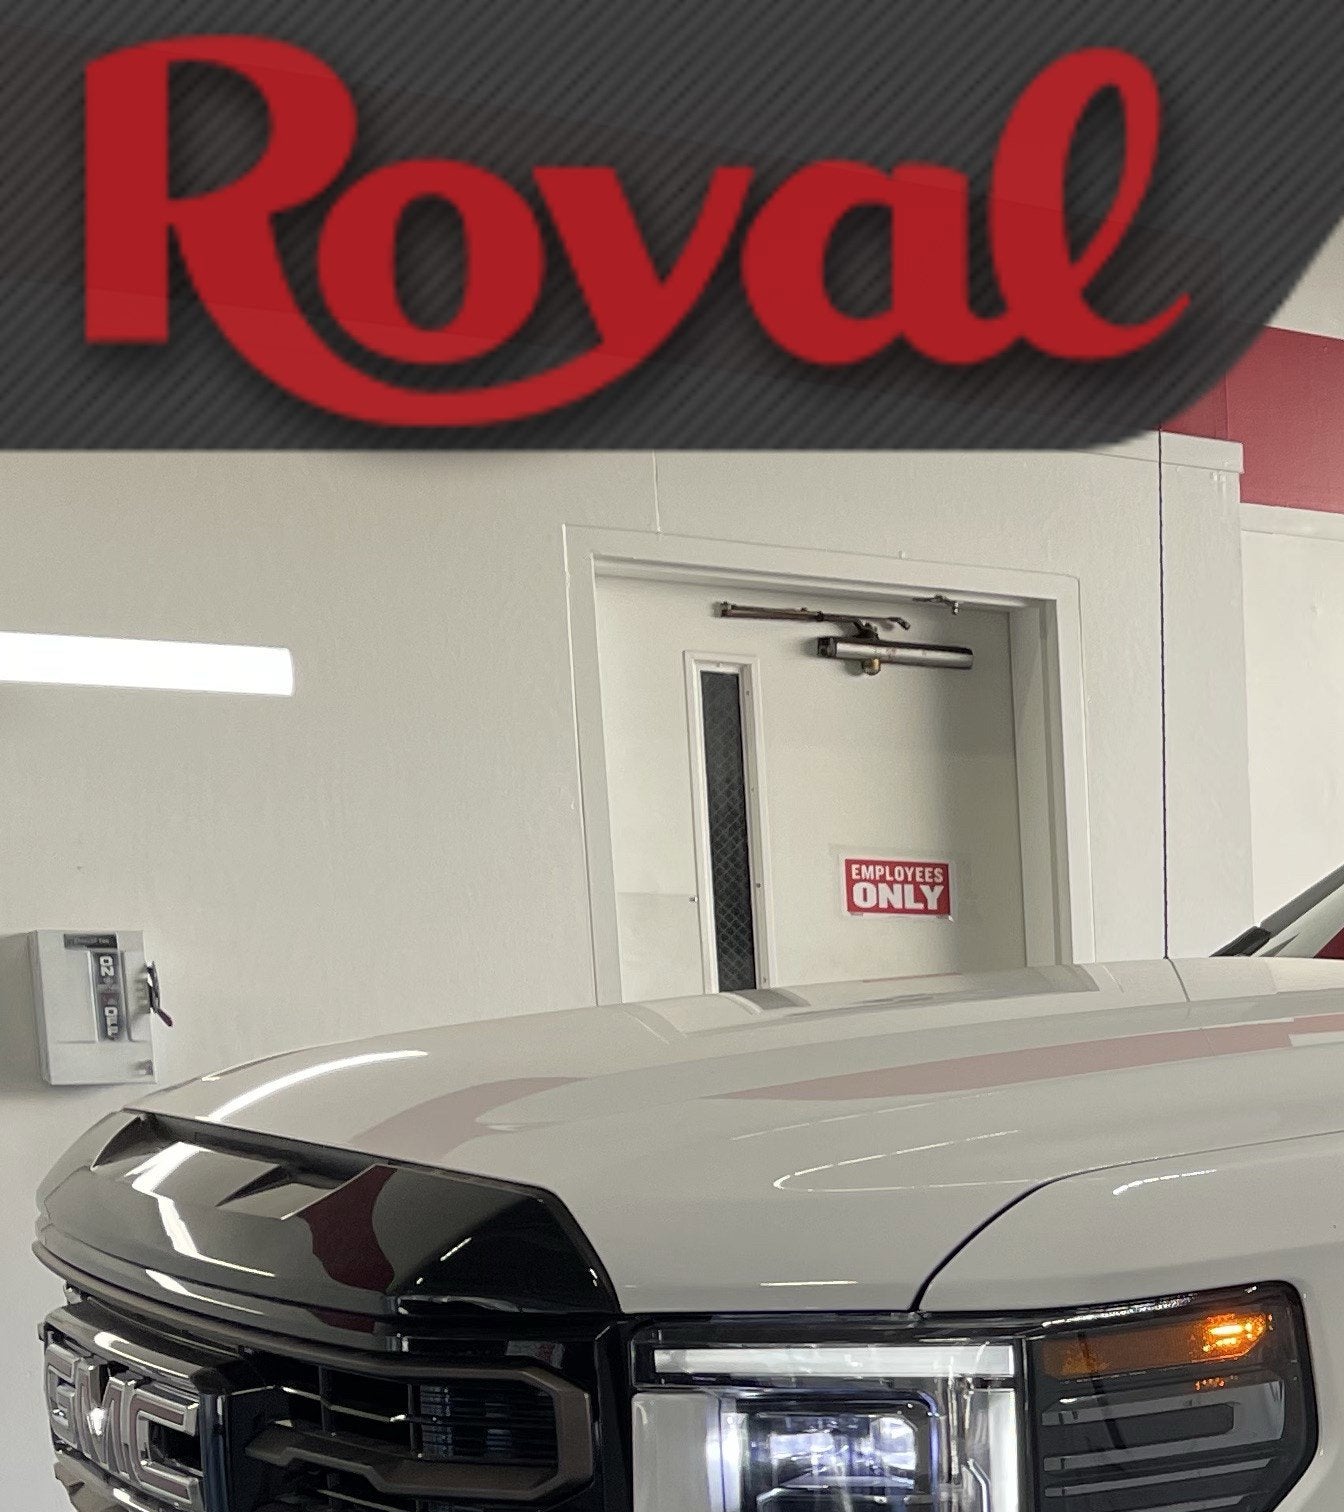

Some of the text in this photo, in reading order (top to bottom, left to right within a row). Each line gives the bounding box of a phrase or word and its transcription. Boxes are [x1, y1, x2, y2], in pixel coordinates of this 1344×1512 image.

[851, 863, 944, 883] EMPLOYEES
[852, 881, 945, 910] ONLY
[99, 955, 115, 977] ON
